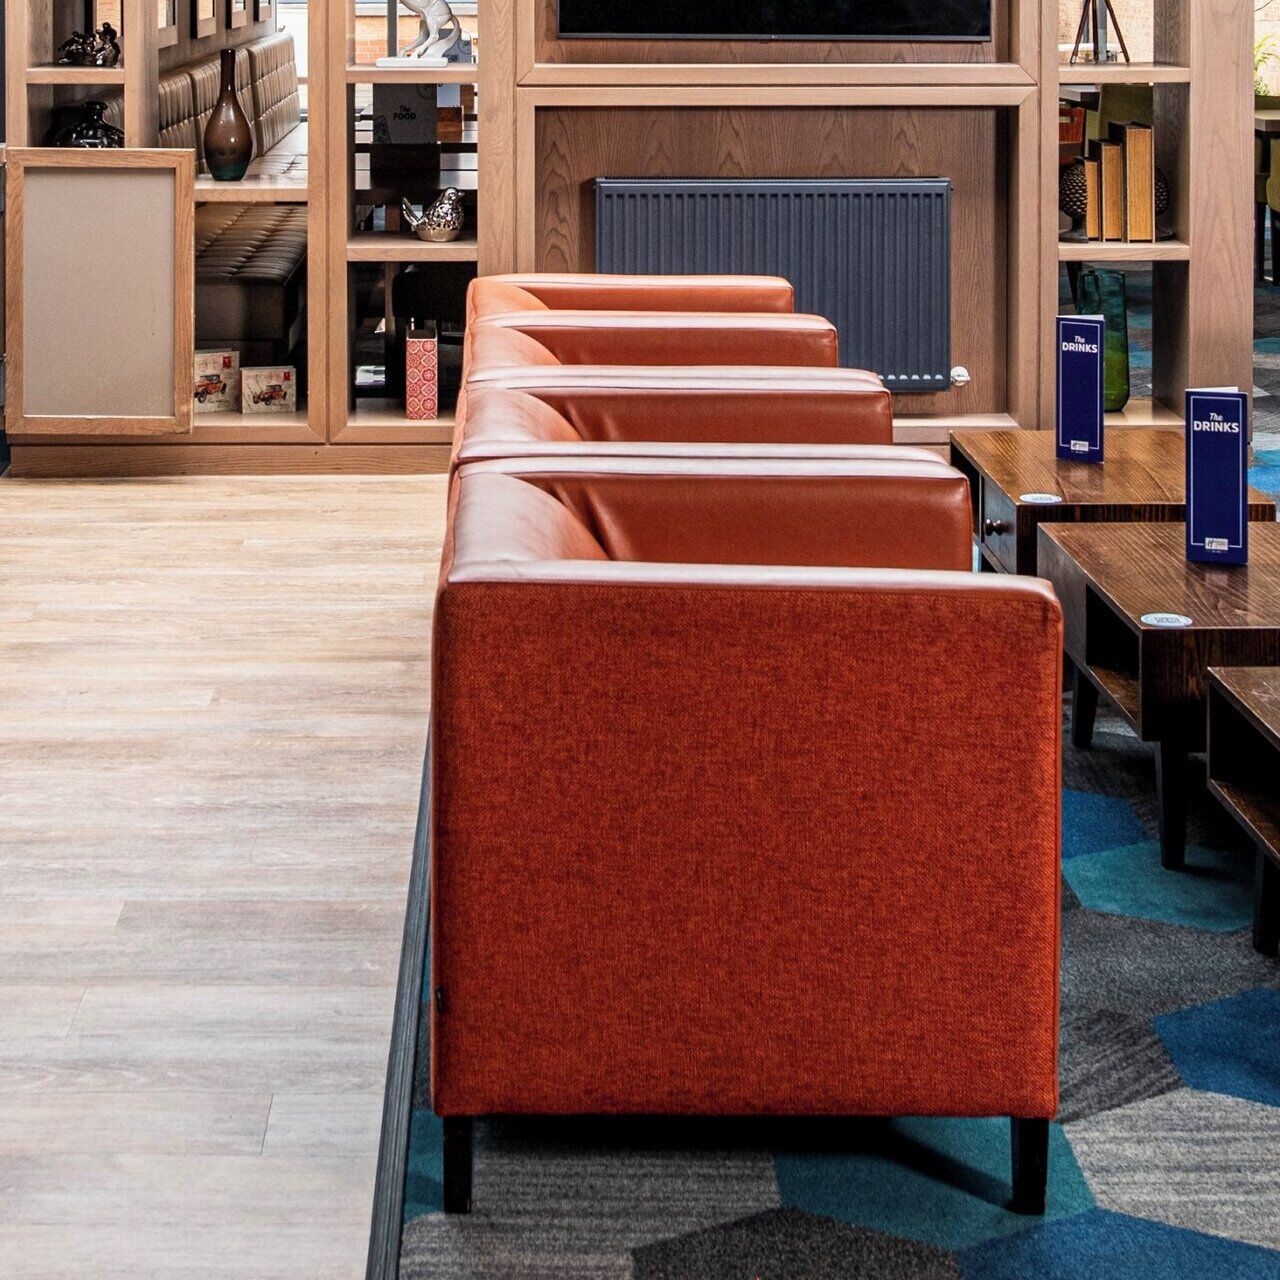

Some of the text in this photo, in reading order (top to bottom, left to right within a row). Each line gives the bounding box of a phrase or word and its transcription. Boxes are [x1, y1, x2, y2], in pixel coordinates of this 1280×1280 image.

[1062, 342, 1098, 353] DRINKS
[1209, 412, 1223, 421] The
[1193, 421, 1239, 433] DRINKS
